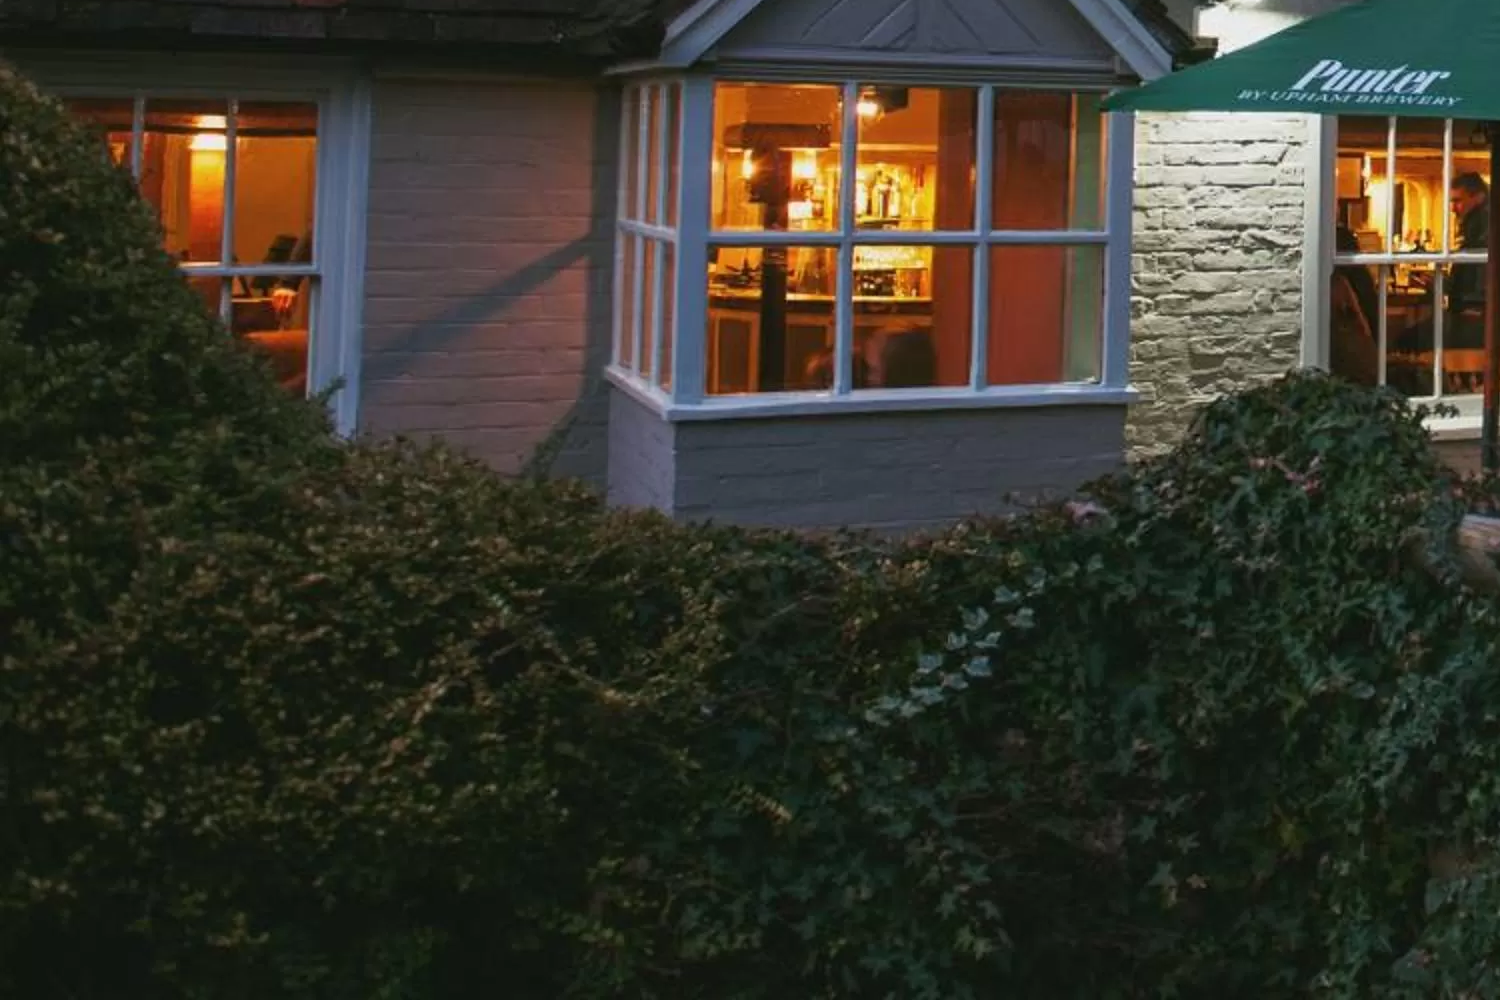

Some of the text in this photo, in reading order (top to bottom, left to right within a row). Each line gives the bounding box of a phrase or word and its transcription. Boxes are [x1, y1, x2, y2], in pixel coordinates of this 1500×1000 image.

[1289, 59, 1452, 94] Punter
[1237, 89, 1463, 107] BY UPHAM BREWERY
